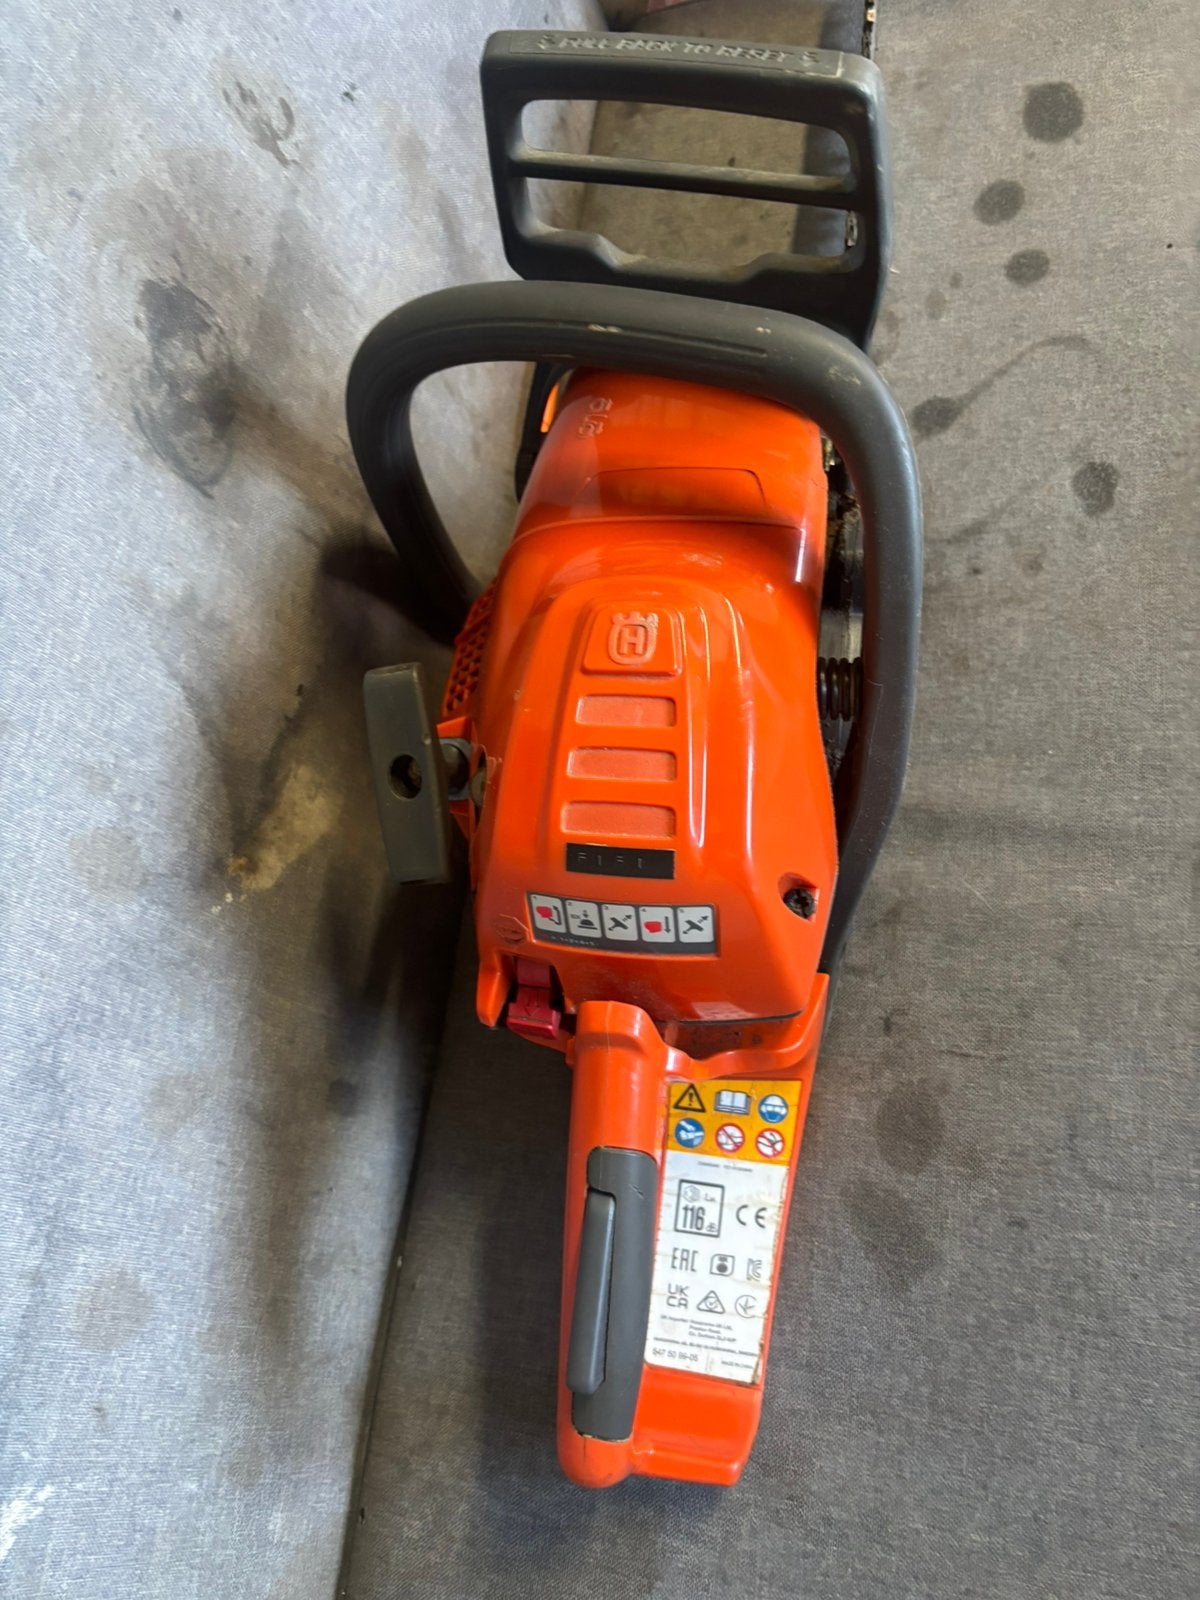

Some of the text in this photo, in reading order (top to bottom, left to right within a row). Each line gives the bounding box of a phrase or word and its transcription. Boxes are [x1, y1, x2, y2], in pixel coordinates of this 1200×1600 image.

[558, 37, 794, 62] PULL BACK TO RESET
[682, 1204, 706, 1231] 116
[736, 1204, 767, 1229] CE
[666, 1296, 689, 1309] CA
[668, 1283, 690, 1297] UK
